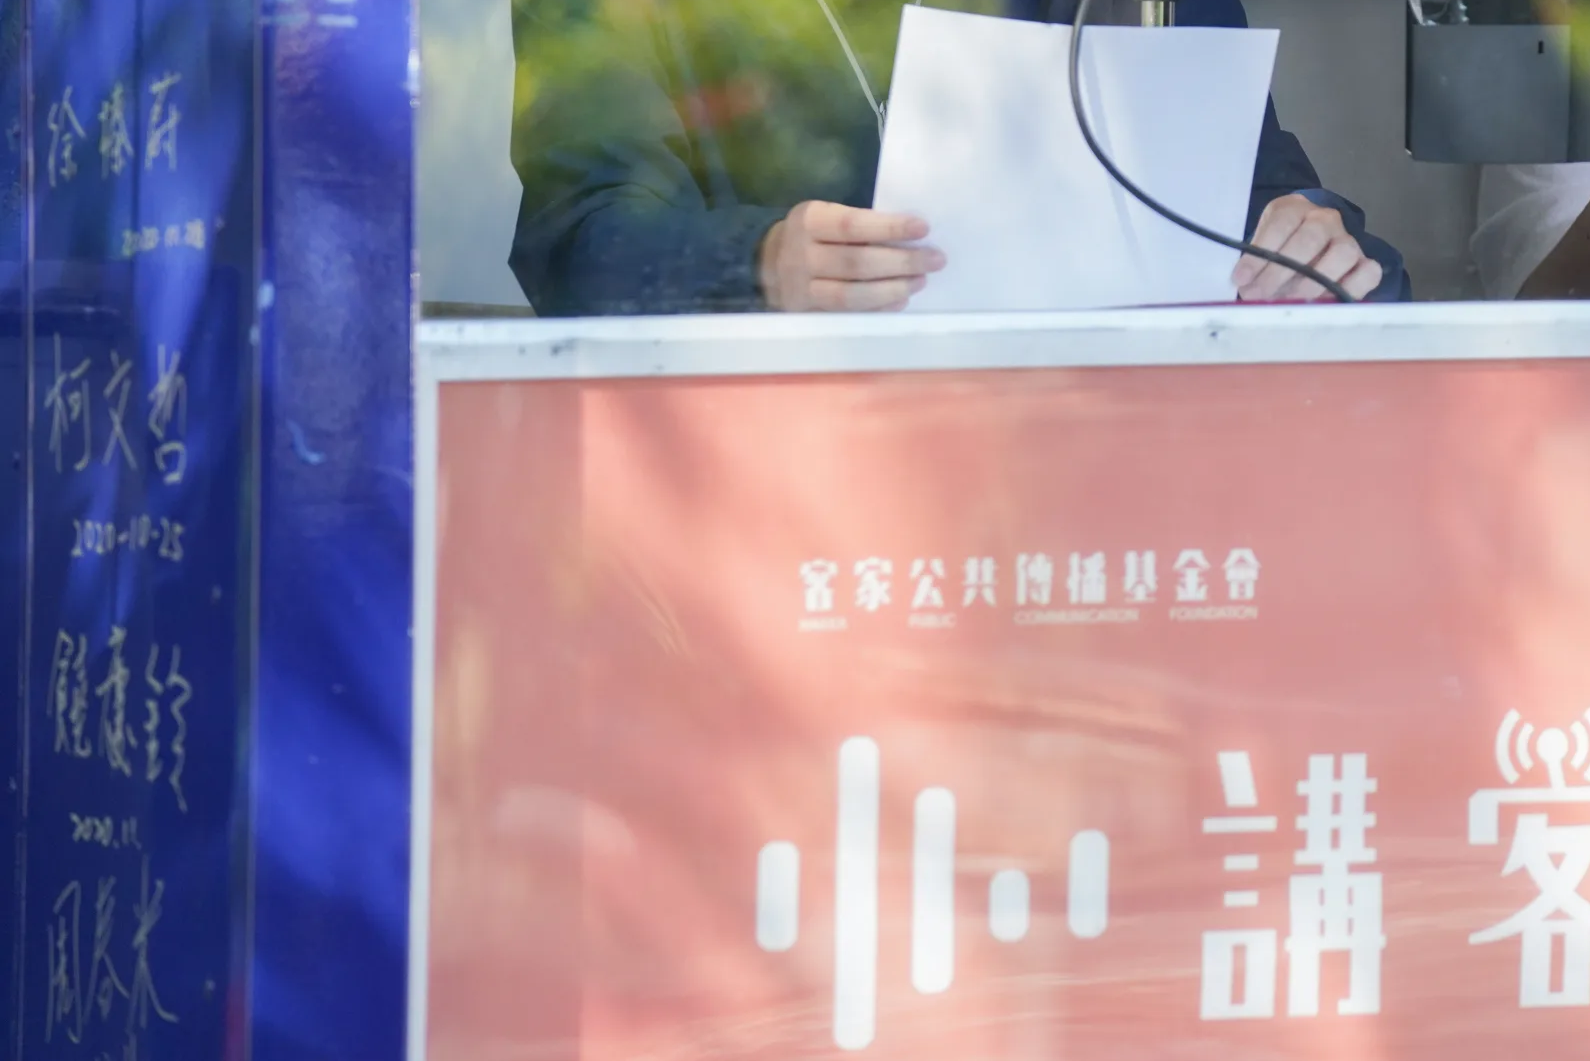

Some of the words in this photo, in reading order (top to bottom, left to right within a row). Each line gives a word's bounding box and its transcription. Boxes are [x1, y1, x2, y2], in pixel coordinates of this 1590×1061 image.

[44, 332, 189, 485] 柯文哲
[798, 547, 1262, 612] 客家公共傳播基金會
